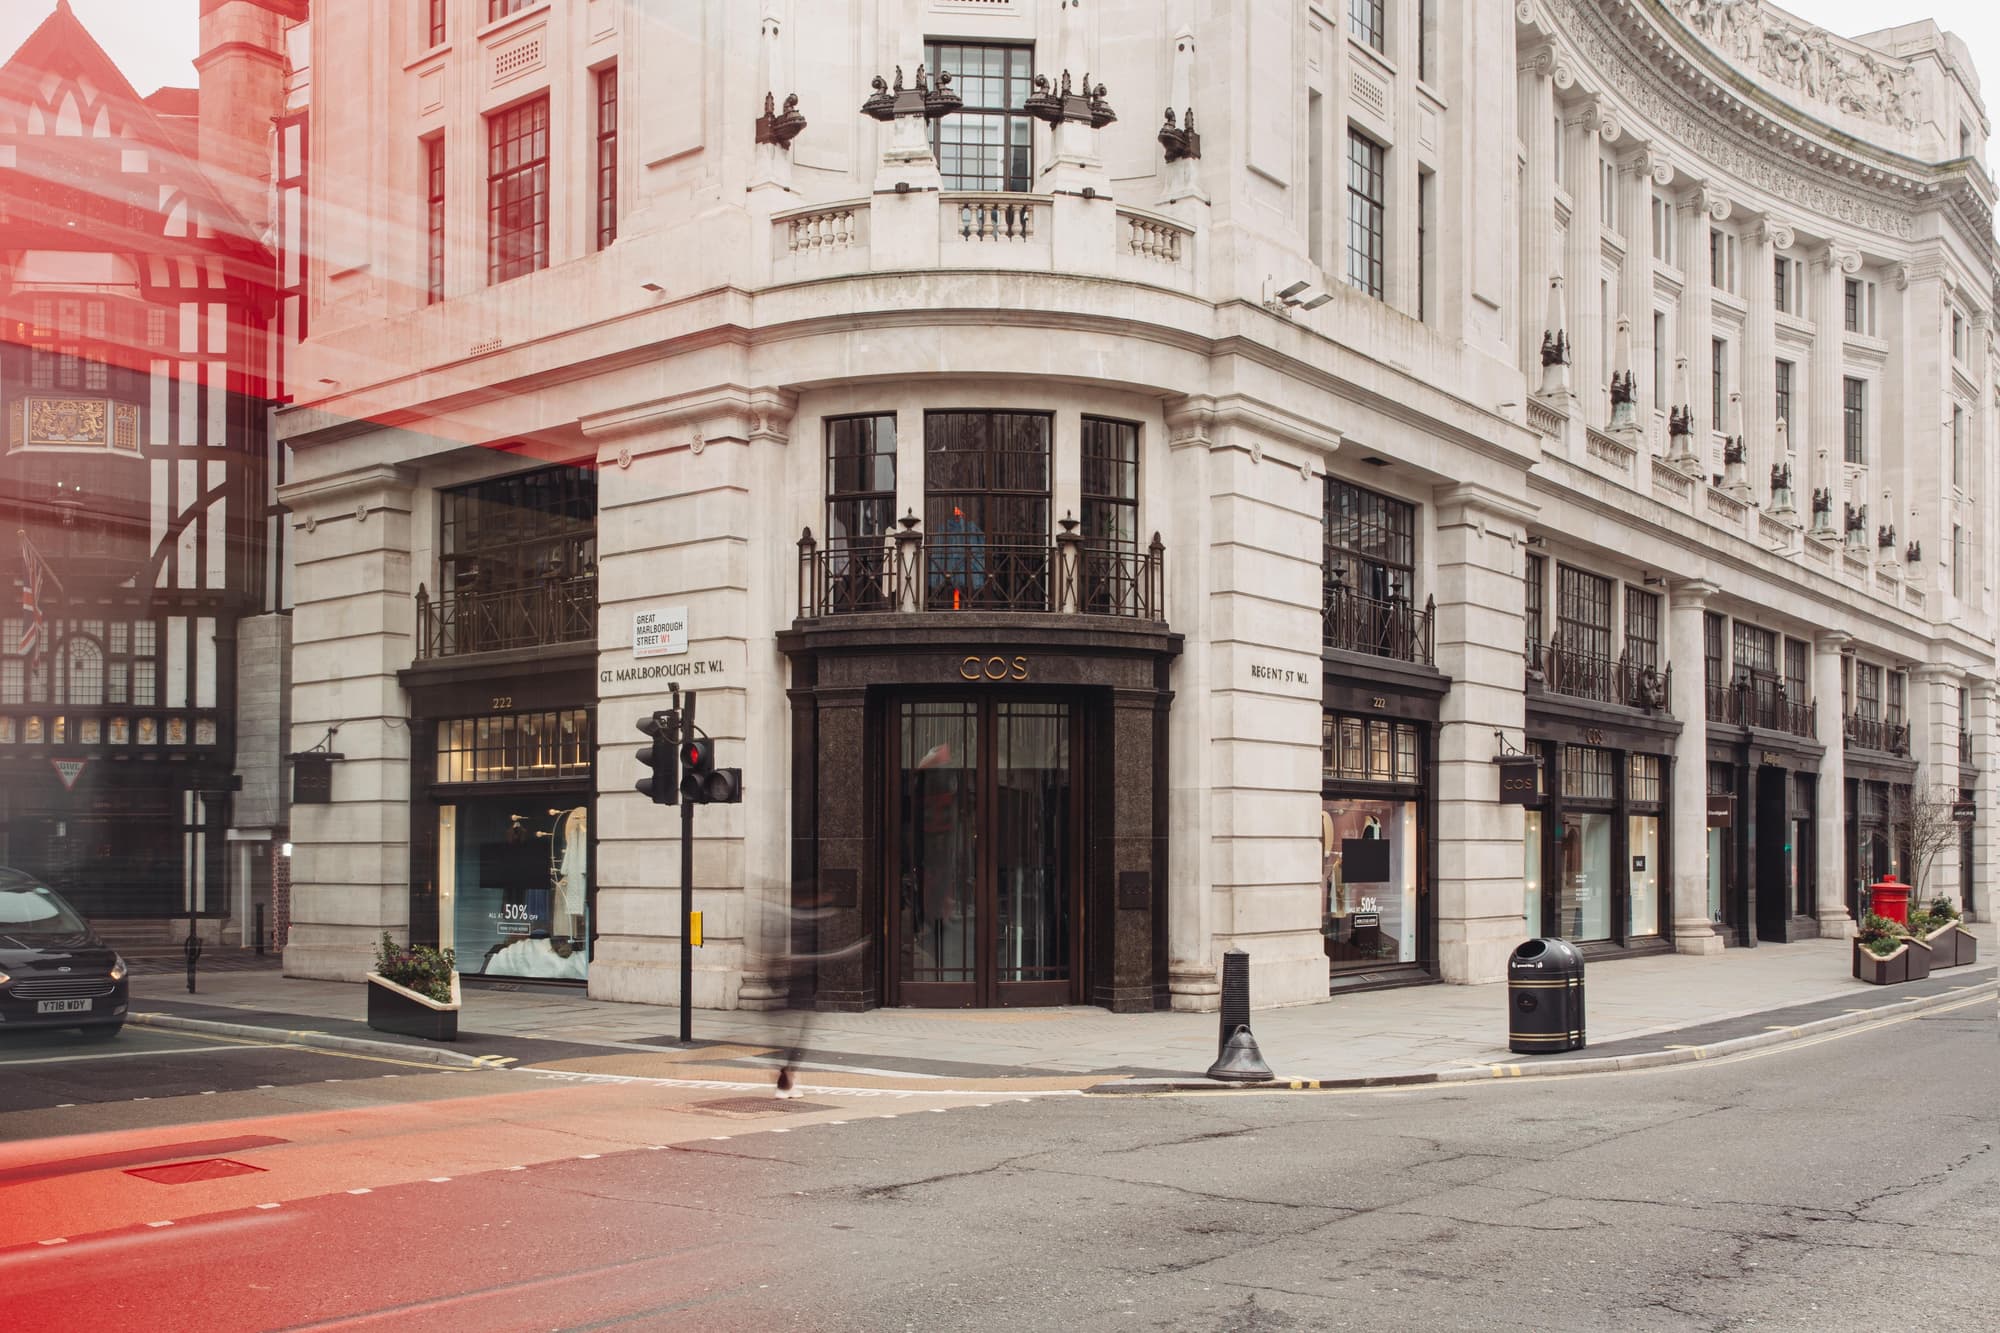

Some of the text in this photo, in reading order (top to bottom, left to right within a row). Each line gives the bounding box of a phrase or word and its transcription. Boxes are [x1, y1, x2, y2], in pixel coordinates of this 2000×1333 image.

[636, 614, 656, 625] GREAT
[636, 622, 684, 635] MARLBOROUGH
[636, 634, 670, 646] STREET W1
[616, 663, 691, 681] MARLBOROUGH
[960, 656, 1028, 680] COS
[1251, 664, 1282, 681] REGENT
[1285, 670, 1294, 682] ST
[492, 697, 512, 709] 222
[1503, 778, 1533, 790] COS
[505, 903, 528, 920] 50%
[1361, 896, 1377, 913] 50%
